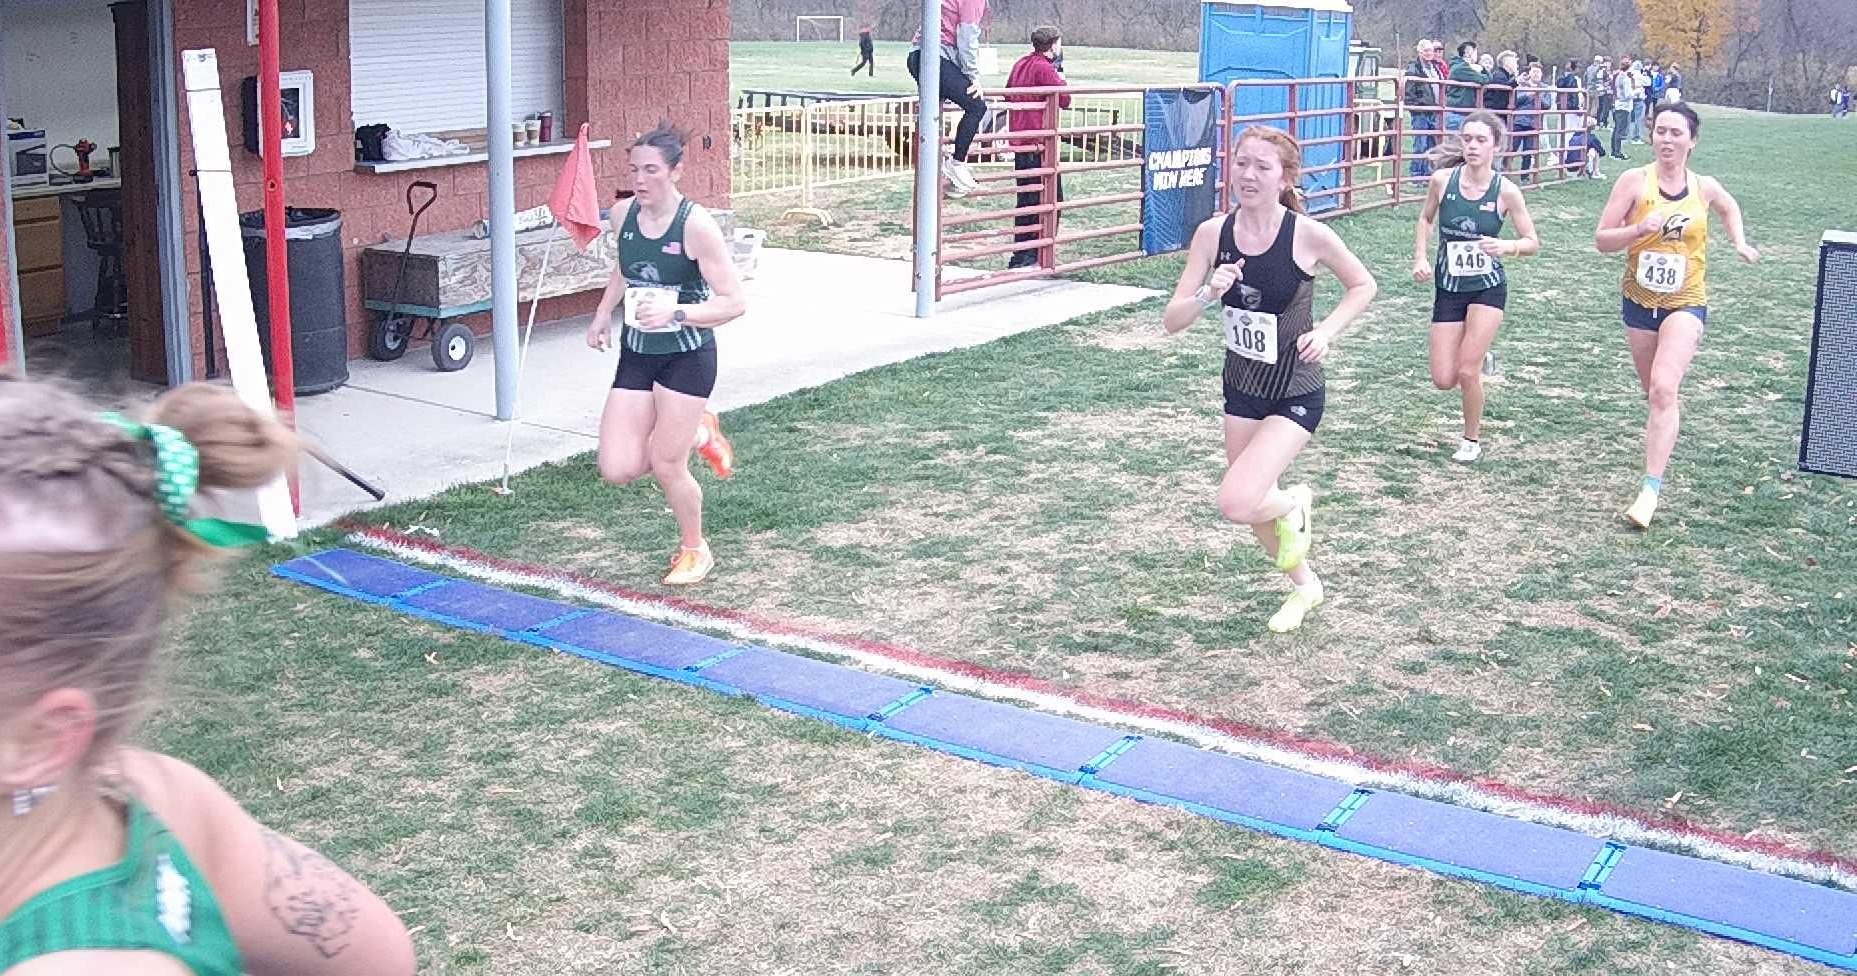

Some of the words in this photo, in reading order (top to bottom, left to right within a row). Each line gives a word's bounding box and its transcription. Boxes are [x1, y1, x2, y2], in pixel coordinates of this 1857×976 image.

[1148, 148, 1212, 170] CHAMPIONS
[1153, 170, 1177, 190] WIN
[1178, 168, 1207, 188] HERE
[1455, 253, 1485, 269] 446
[1645, 265, 1676, 285] 438
[1232, 325, 1266, 353] 108
